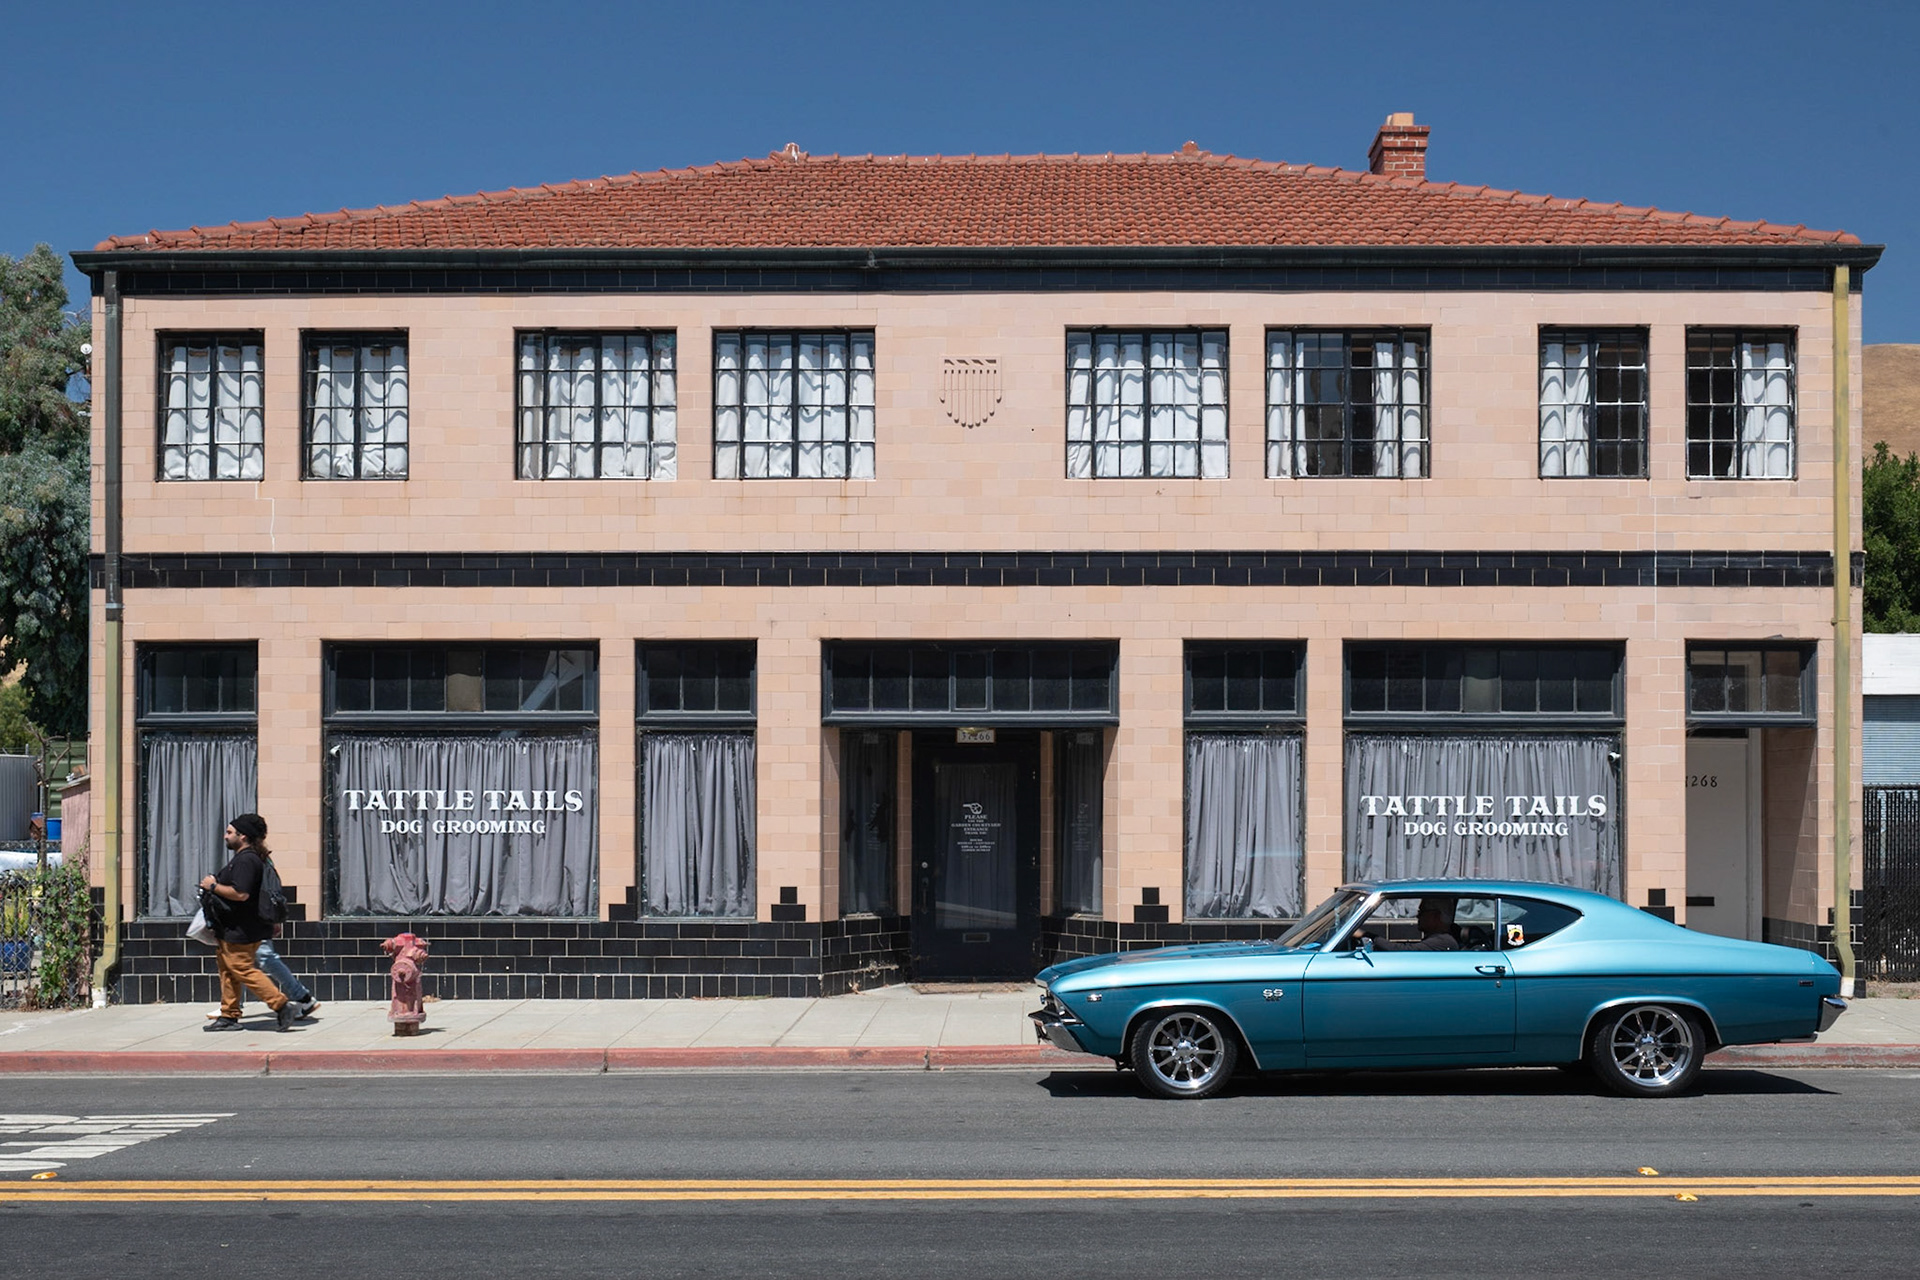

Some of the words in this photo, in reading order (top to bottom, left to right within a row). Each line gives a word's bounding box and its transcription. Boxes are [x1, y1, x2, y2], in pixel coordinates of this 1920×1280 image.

[343, 789, 475, 811] TATTLE
[483, 789, 583, 812] TAILS
[1360, 795, 1495, 816] TATTLE
[1505, 795, 1607, 817] TAILS
[381, 819, 423, 834] DOG
[432, 819, 546, 834] GROOMING
[1404, 821, 1447, 836] DOG
[1453, 821, 1569, 836] GROOMING
[1262, 988, 1284, 997] SS
